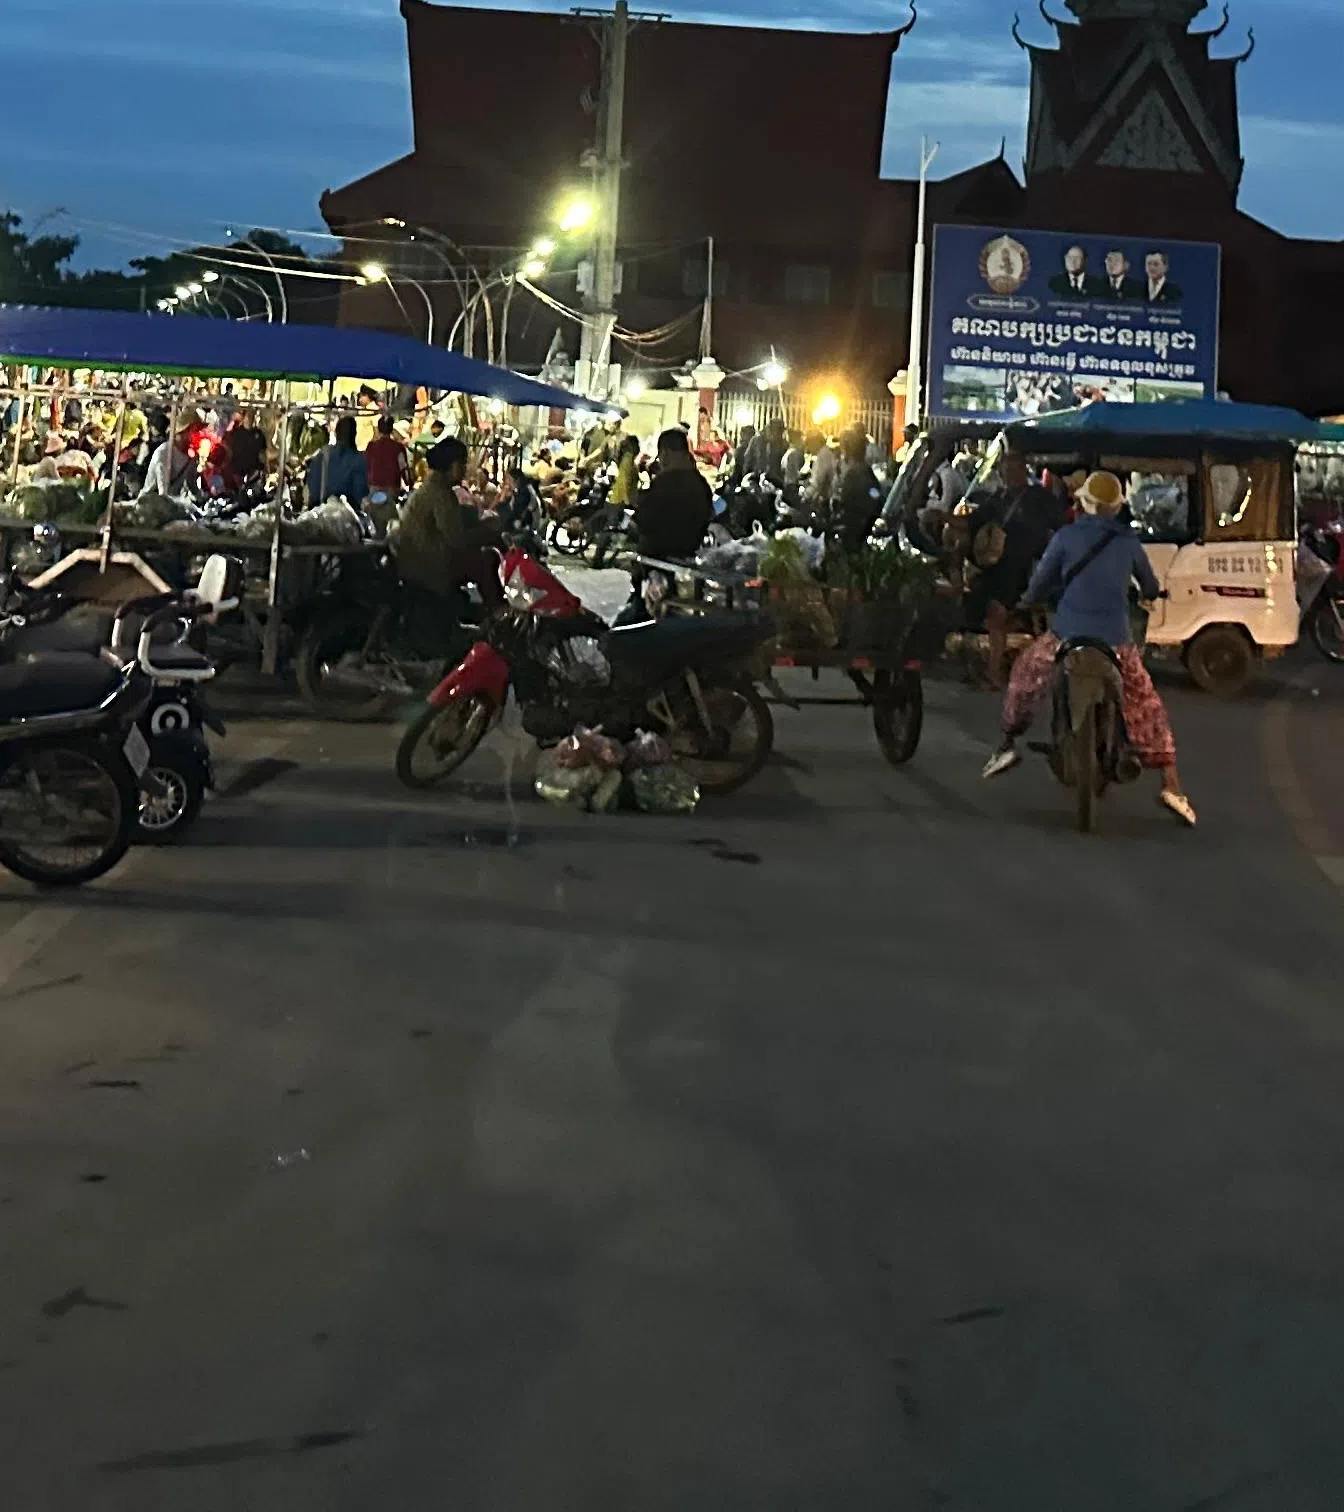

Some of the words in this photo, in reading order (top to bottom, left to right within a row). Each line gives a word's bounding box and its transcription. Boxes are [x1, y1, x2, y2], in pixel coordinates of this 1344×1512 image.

[951, 316, 1196, 359] គណបក្សប្រជាជនកម្ពុជា
